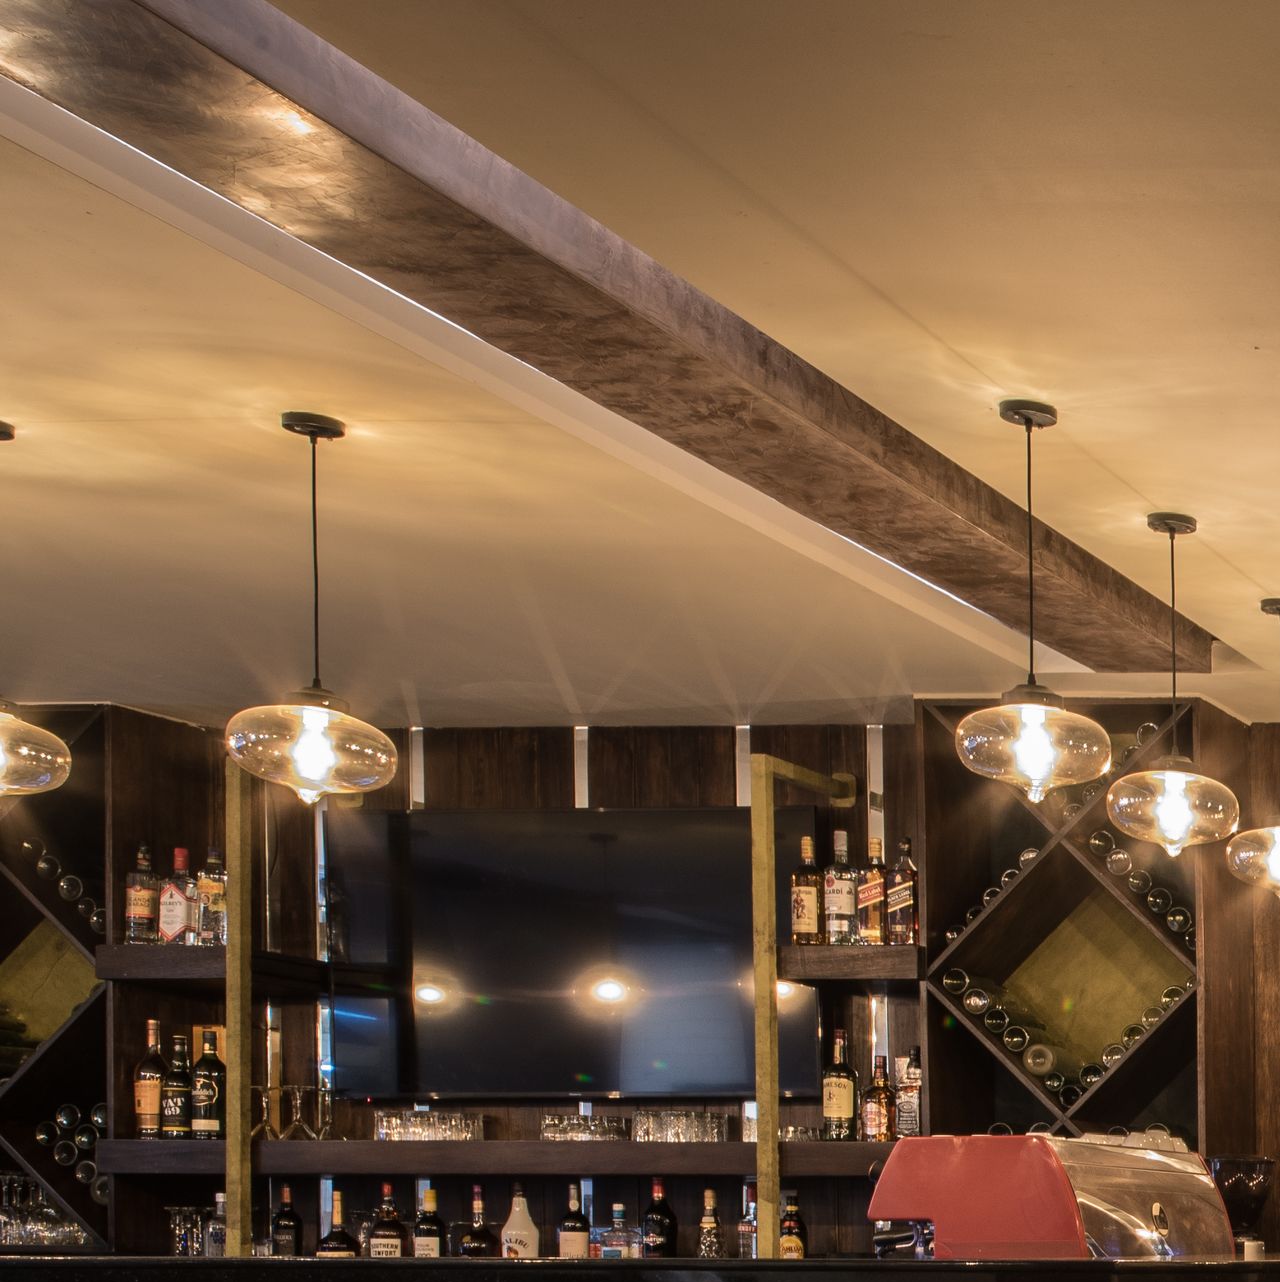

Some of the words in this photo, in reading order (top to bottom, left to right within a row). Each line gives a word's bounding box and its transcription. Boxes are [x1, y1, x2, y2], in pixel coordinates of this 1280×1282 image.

[823, 1081, 848, 1090] AMESON
[162, 1097, 185, 1108] VAT
[164, 1107, 180, 1116] 69
